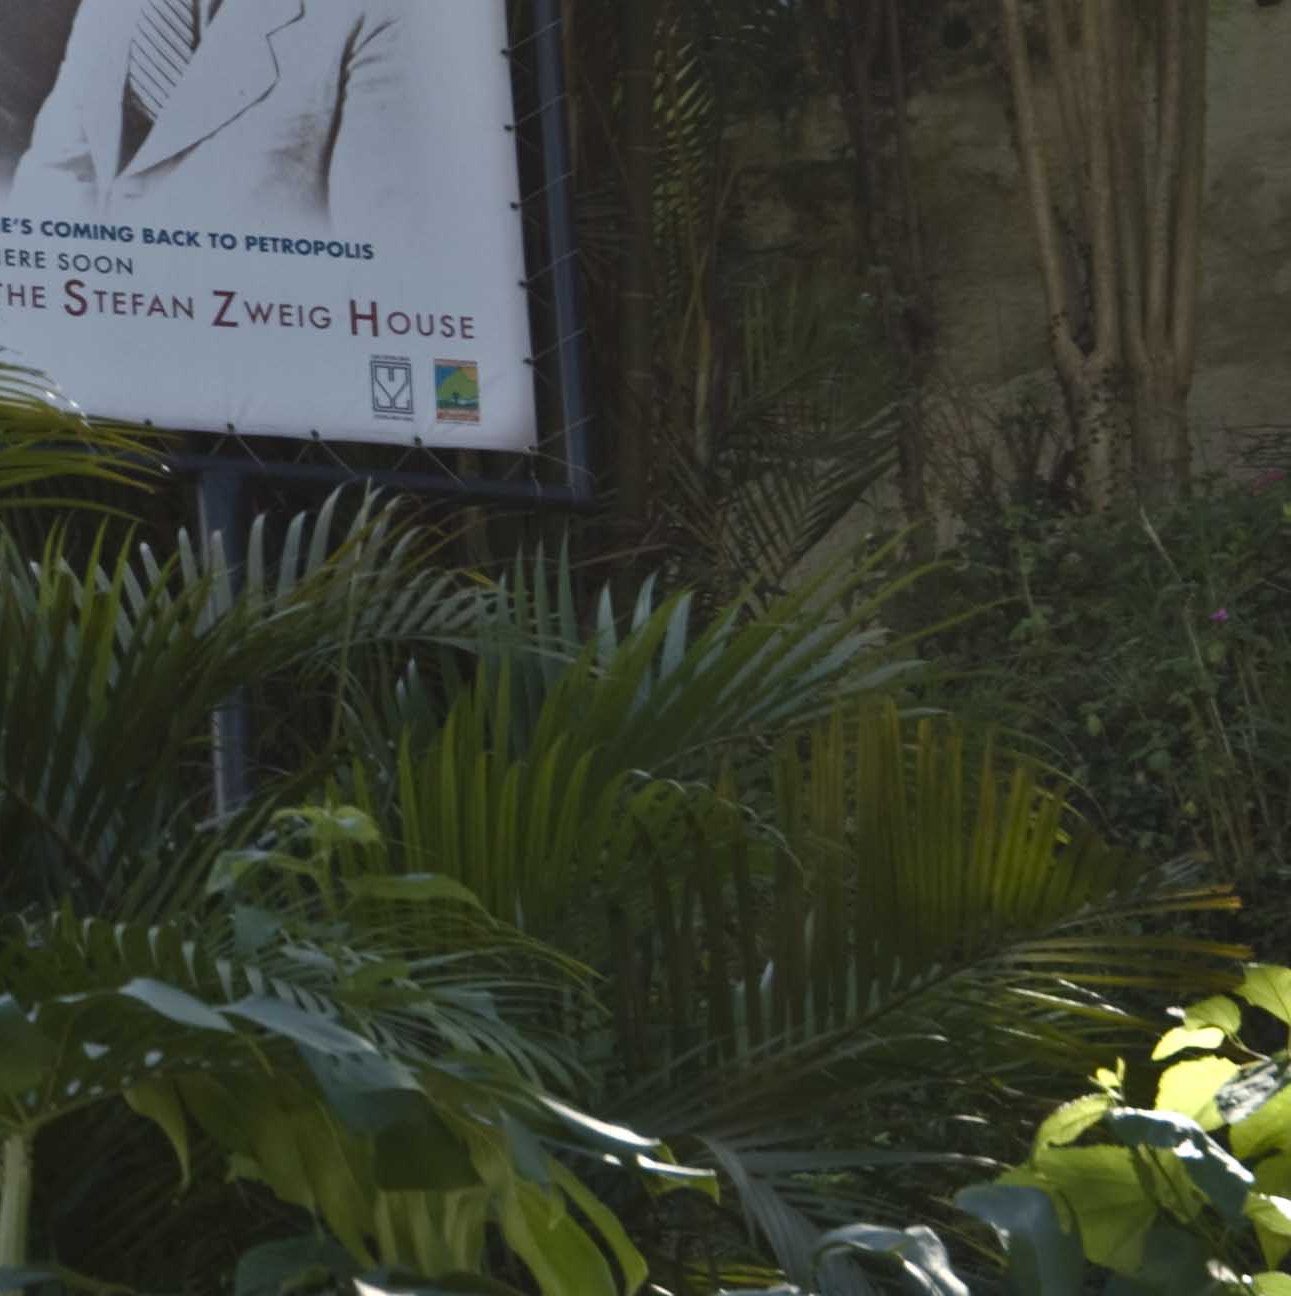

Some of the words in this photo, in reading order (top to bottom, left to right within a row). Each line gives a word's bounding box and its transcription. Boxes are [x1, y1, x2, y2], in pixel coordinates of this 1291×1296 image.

[40, 220, 134, 243] COMING
[142, 227, 201, 248] BACK
[208, 232, 237, 250] TO
[245, 235, 375, 260] PETROPOLIS
[58, 253, 134, 275] SOON
[63, 279, 194, 320] STEFAN
[211, 289, 332, 329] ZWEIG
[349, 299, 475, 339] HOUSE
